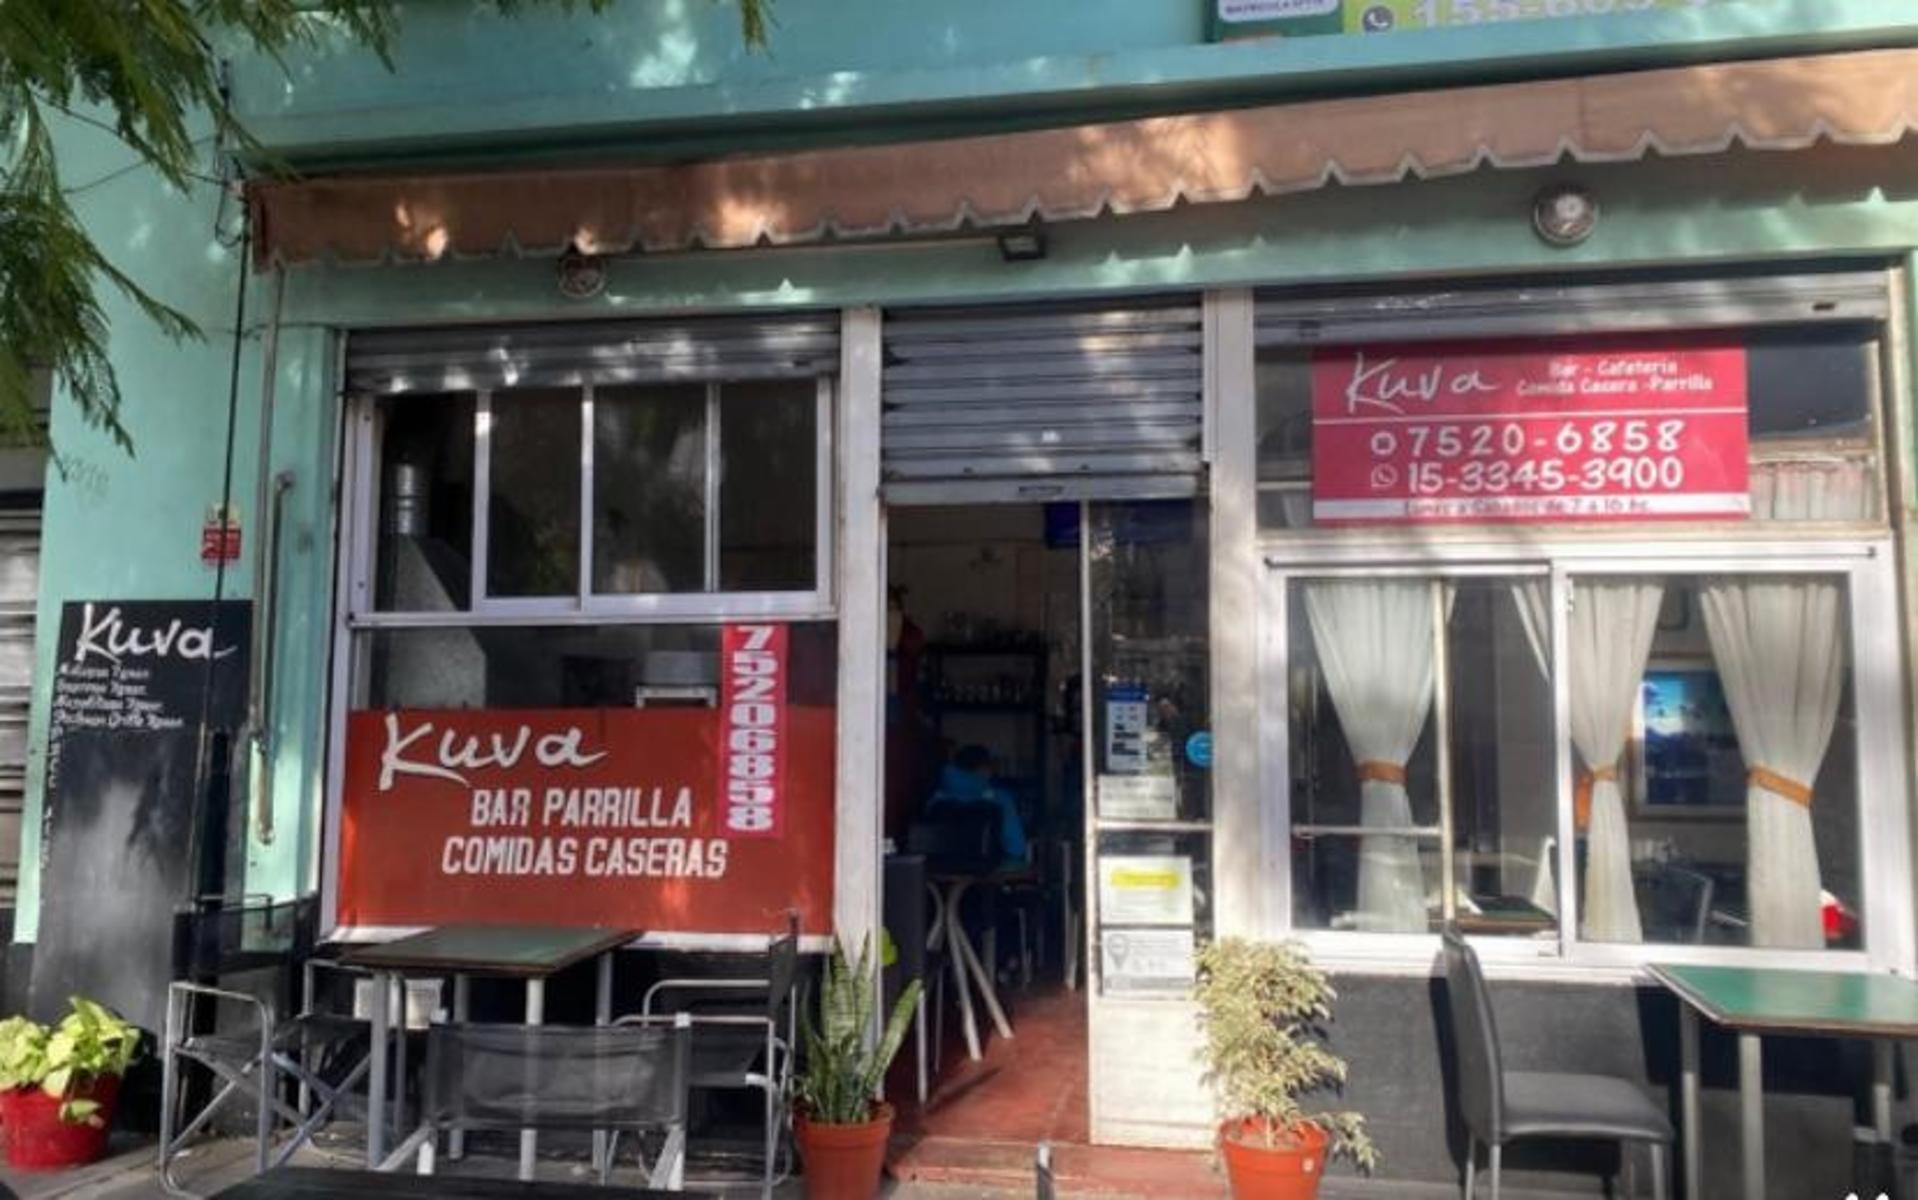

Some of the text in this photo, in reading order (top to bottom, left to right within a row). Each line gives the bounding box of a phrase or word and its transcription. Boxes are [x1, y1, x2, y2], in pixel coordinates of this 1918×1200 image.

[1345, 352, 1498, 414] Kuva
[1516, 379, 1575, 396] Comida
[1580, 377, 1638, 394] Casera
[1550, 359, 1578, 377] Bar
[1408, 457, 1684, 493] 15-3345-3900
[74, 603, 238, 664] Kuva
[726, 624, 778, 831] 75206858
[378, 713, 609, 791] Kuva
[471, 787, 692, 828] BAR PARRILLA
[442, 836, 728, 879] COMIDAS CASERAS
